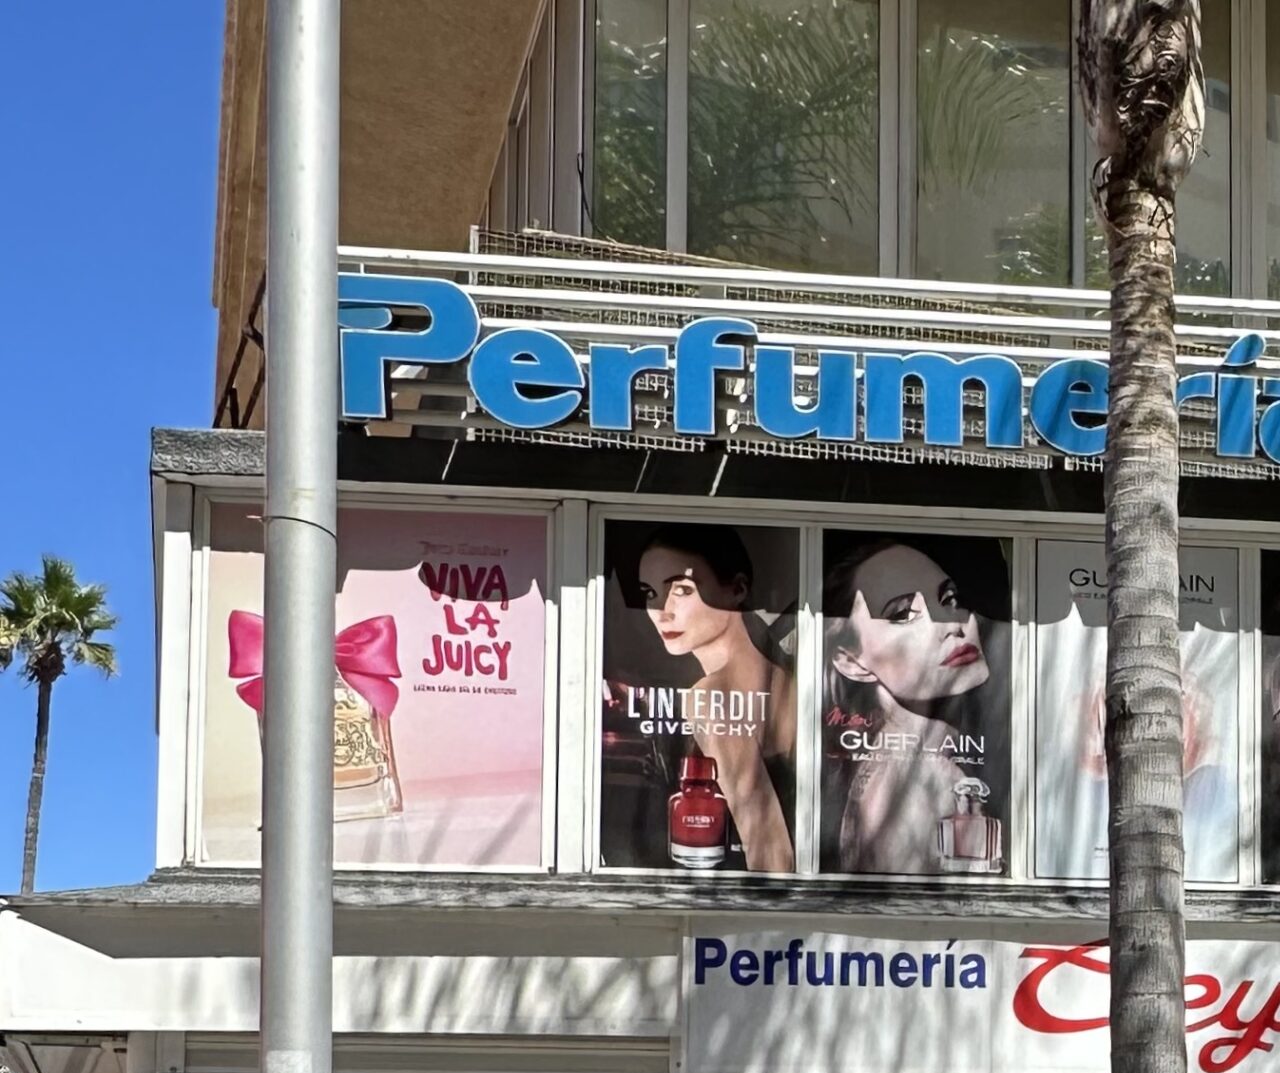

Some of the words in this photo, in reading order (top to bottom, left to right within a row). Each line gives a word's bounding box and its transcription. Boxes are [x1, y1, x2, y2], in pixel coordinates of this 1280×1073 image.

[421, 561, 509, 611] VIVA
[443, 603, 500, 638] LA
[422, 634, 512, 681] JUICY
[627, 686, 771, 722] L'INTERDIT
[640, 721, 757, 736] GIVENCHY
[694, 938, 987, 989] Perfumería
